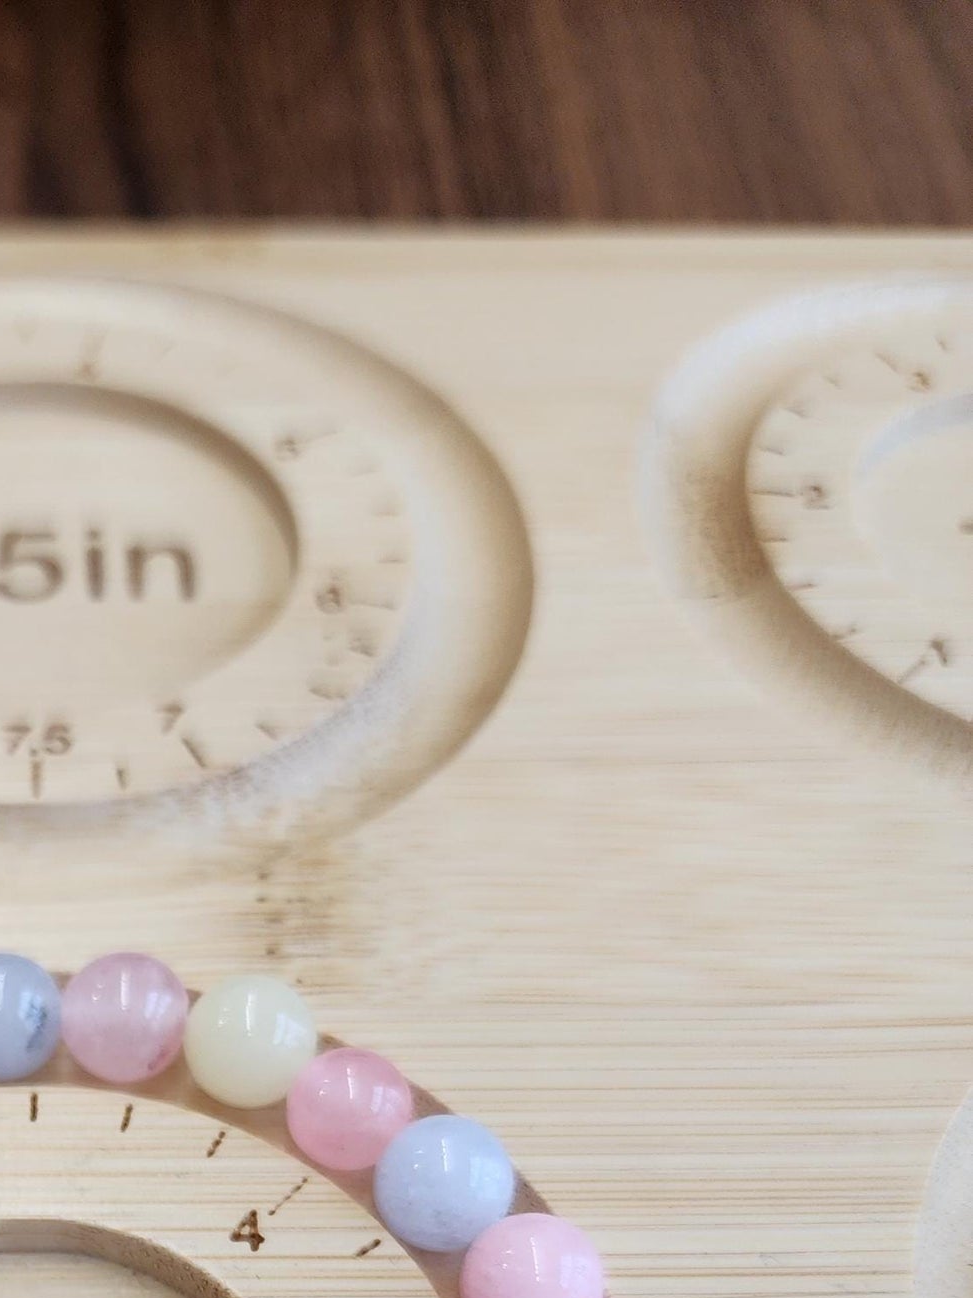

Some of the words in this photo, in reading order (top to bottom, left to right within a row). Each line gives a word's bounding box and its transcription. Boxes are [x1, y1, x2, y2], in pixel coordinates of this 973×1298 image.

[158, 701, 184, 736] 7
[3, 721, 73, 757] 7.5
[230, 1208, 267, 1252] 4
